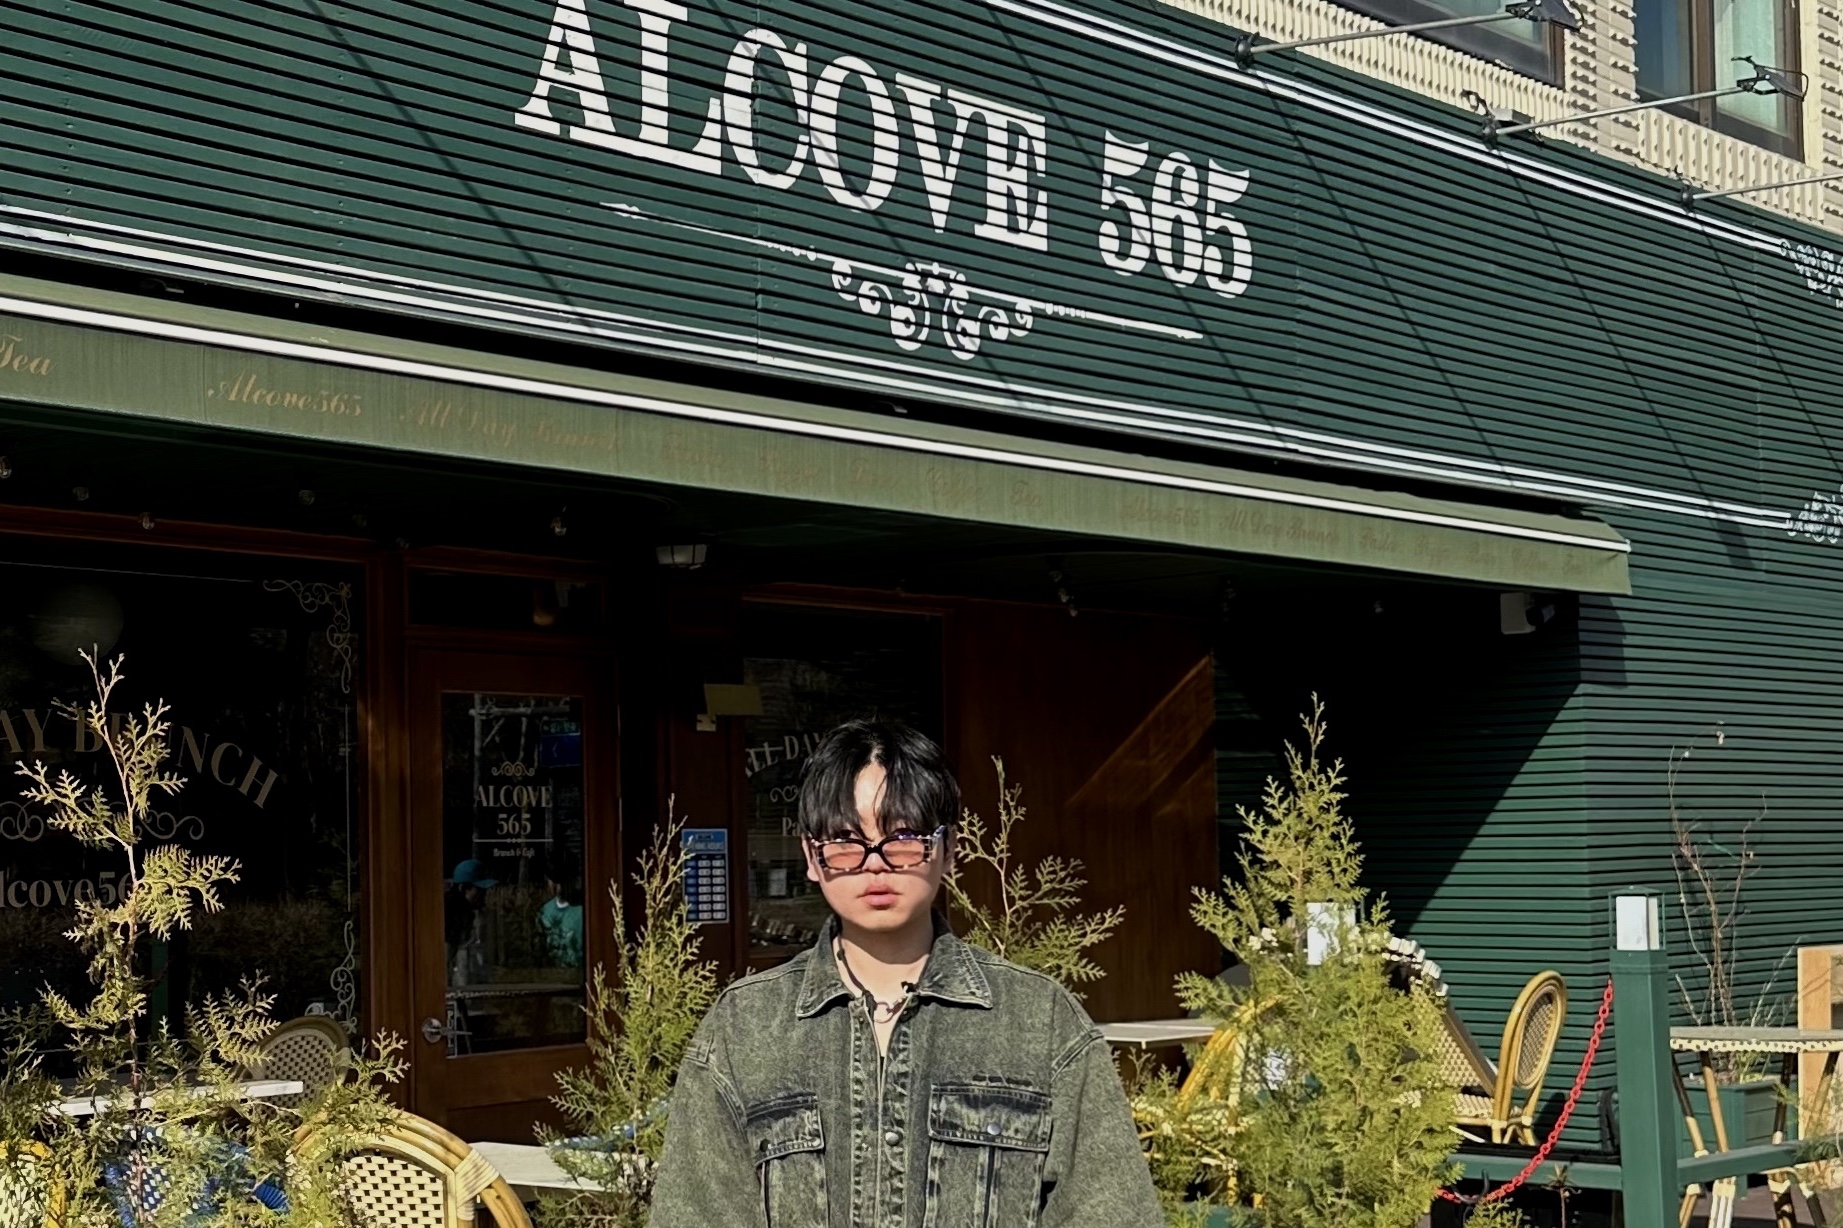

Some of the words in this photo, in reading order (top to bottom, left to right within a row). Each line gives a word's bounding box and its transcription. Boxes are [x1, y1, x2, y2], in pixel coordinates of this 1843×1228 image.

[514, 0, 1049, 251] ALCOVE
[1098, 129, 1253, 298] 565
[0, 333, 51, 376] Tea
[73, 709, 279, 809] BNCH
[474, 784, 554, 808] ALCOVE
[496, 813, 532, 835] 565
